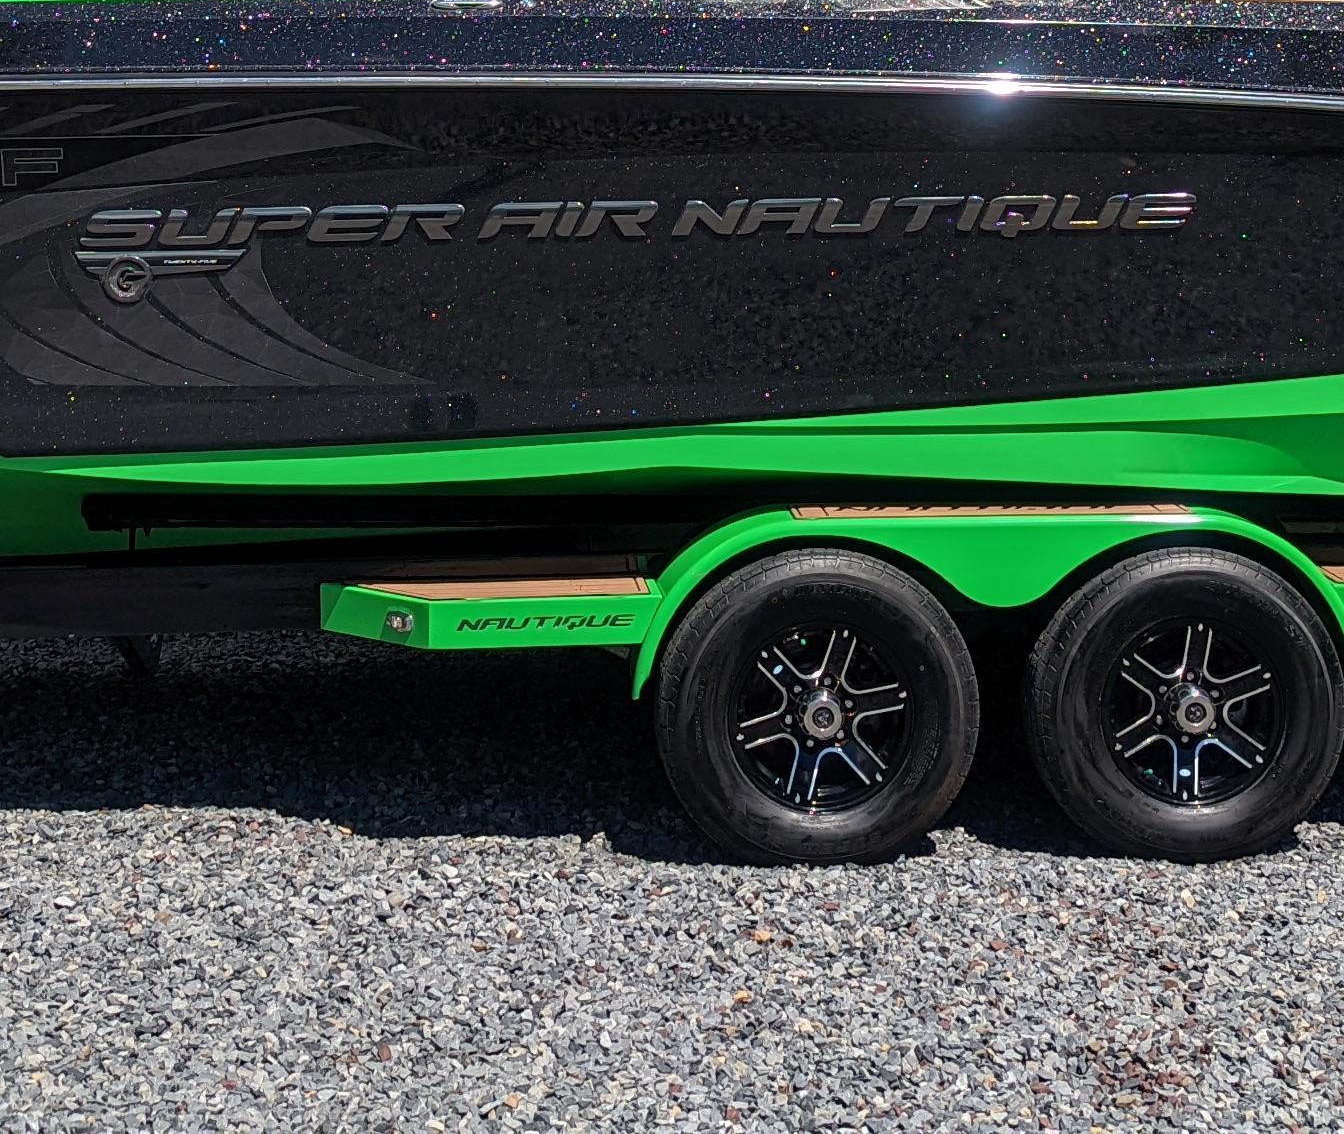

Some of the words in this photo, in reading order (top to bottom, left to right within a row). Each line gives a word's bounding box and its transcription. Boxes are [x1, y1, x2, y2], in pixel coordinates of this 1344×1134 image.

[79, 203, 465, 247] SUPER
[477, 200, 659, 240] AIR
[671, 192, 1197, 238] NAUTIQUE
[455, 613, 637, 632] NAUTIQUE
